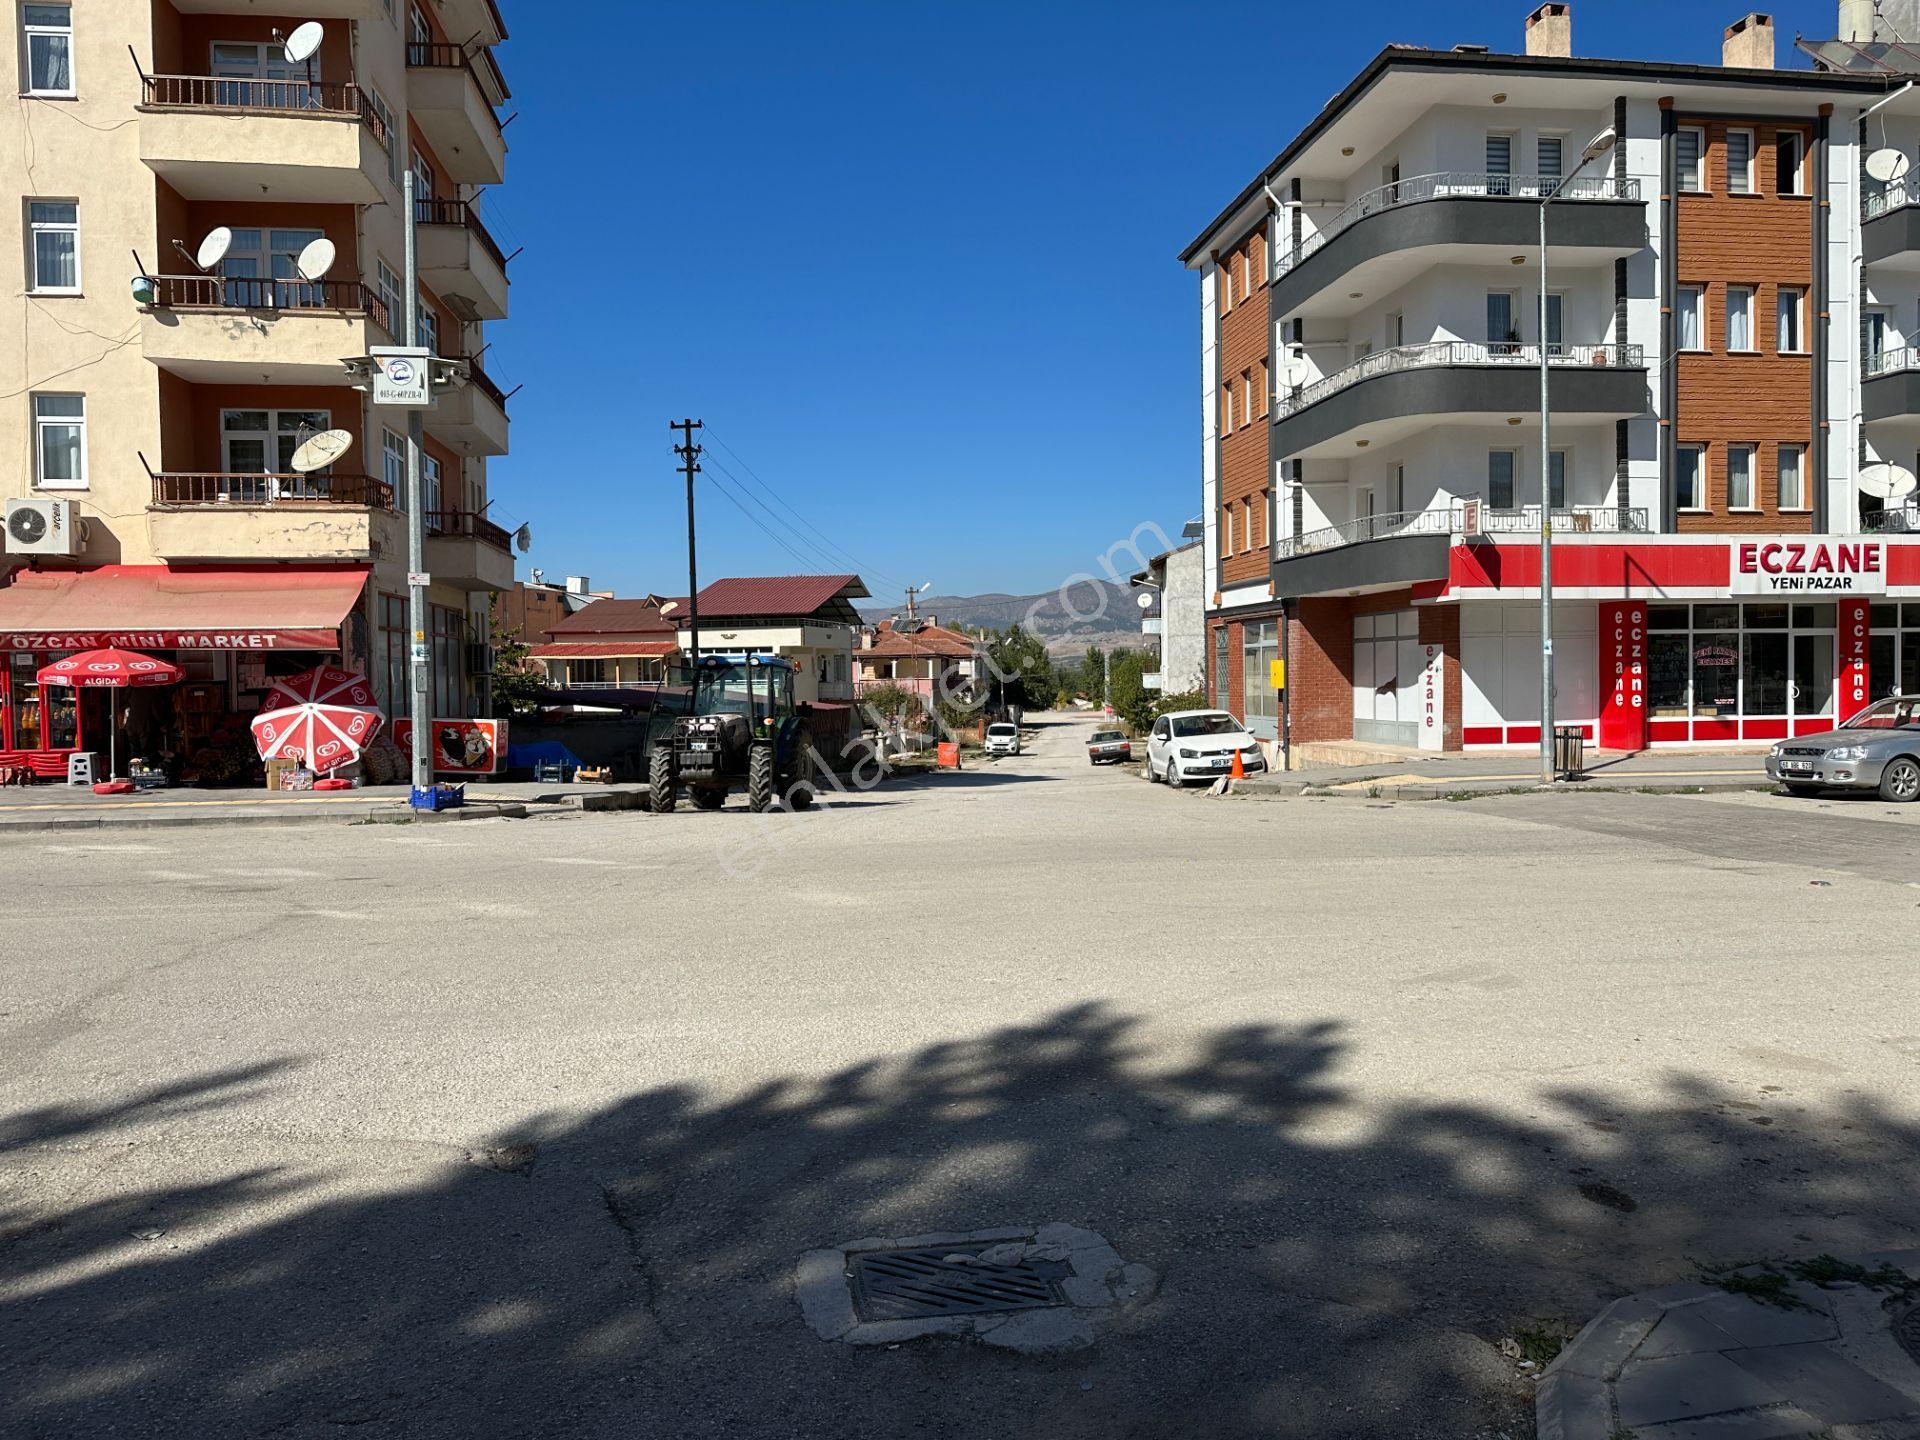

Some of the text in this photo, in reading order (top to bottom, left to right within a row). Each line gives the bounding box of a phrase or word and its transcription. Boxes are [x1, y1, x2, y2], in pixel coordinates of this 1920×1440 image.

[1466, 506, 1477, 531] E
[1739, 543, 1880, 574] ECZANE
[1807, 577, 1852, 589] PAZAR
[11, 634, 97, 648] ÖZCAN
[178, 634, 277, 648] MARKET
[1615, 611, 1624, 707] eczane
[1631, 611, 1642, 708] eczane
[1853, 608, 1864, 701] eczane
[1426, 645, 1434, 727] eczane
